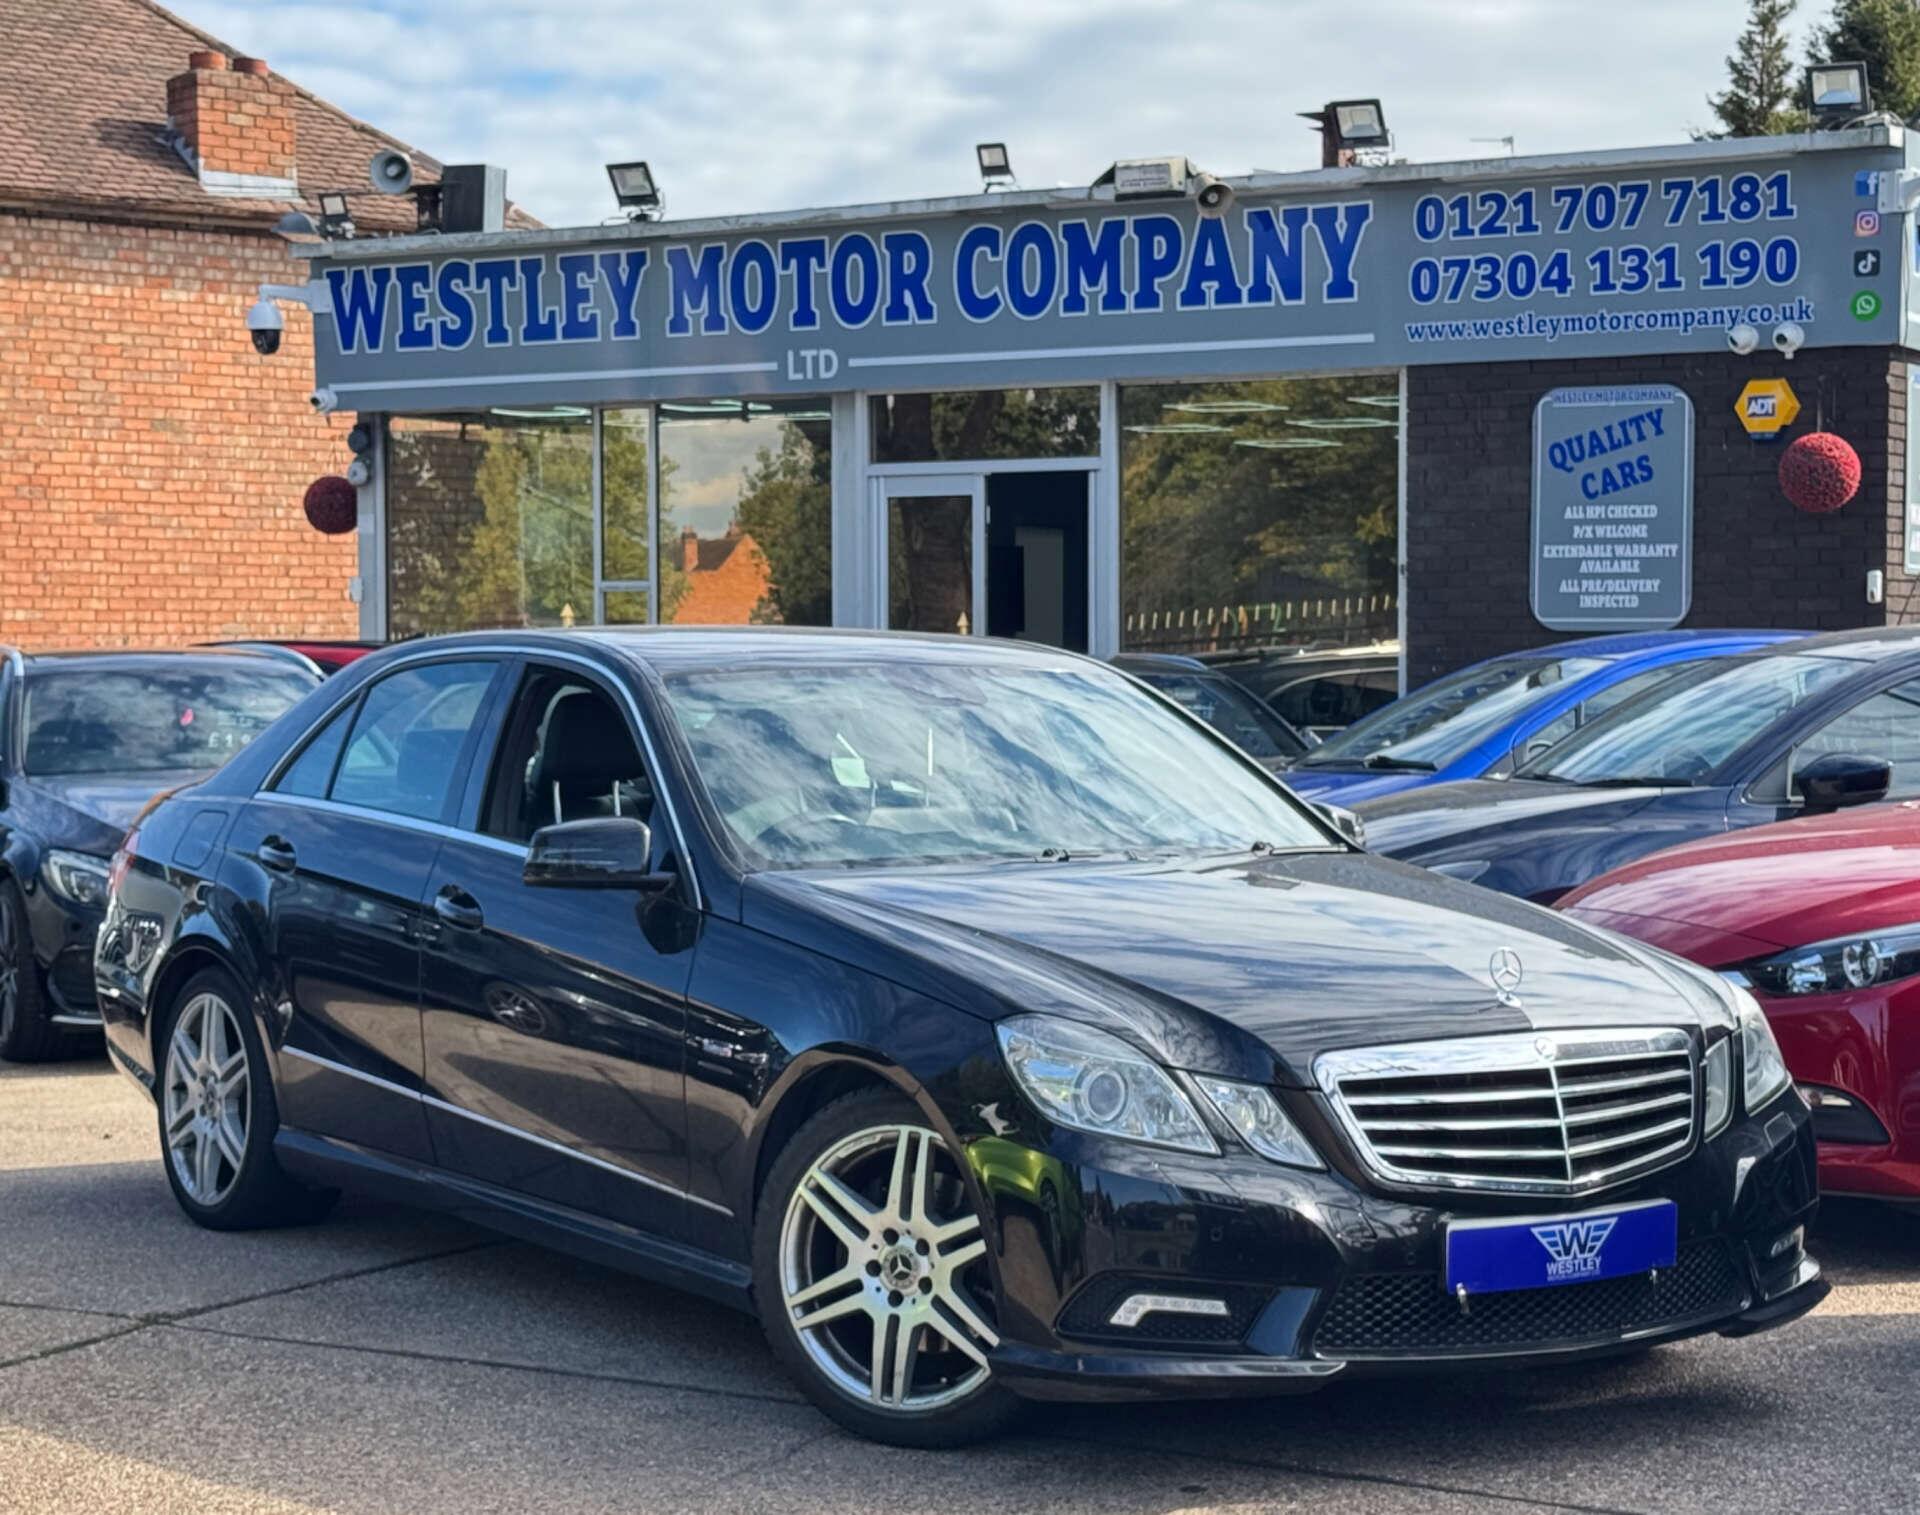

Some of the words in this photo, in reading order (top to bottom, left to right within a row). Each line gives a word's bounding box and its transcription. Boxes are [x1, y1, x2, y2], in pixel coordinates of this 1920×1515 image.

[1414, 189, 1541, 241] 0121
[1552, 179, 1651, 232] 707
[1663, 170, 1797, 227] 7181
[324, 248, 650, 355] WESTLEY
[664, 229, 937, 338] MOTOR
[954, 200, 1374, 323] COMPANY
[1409, 248, 1573, 304] 07304
[1588, 241, 1683, 294] 131
[1697, 235, 1799, 288] 190
[1405, 297, 1815, 342] www.westleymotorcompany.co.uk
[787, 349, 838, 381] LTD
[1747, 396, 1776, 415] ADT
[1548, 408, 1665, 473] QUALITY
[1580, 455, 1654, 500] CARS
[1564, 505, 1584, 519] ALL
[1586, 505, 1605, 519] HPI
[1607, 505, 1658, 519] CHECKED
[1573, 525, 1594, 538] P/X
[1596, 524, 1648, 538] WELCOME
[1543, 544, 1613, 558] EXTENDABLE
[1614, 543, 1678, 557] WARRANTY
[1579, 560, 1640, 574] AVAILABLE
[1559, 580, 1580, 593] ALL
[1581, 579, 1661, 593] PRE/DELIVERY
[1579, 595, 1639, 609] INSPECTED
[1546, 1256, 1602, 1275] WESTLEY
